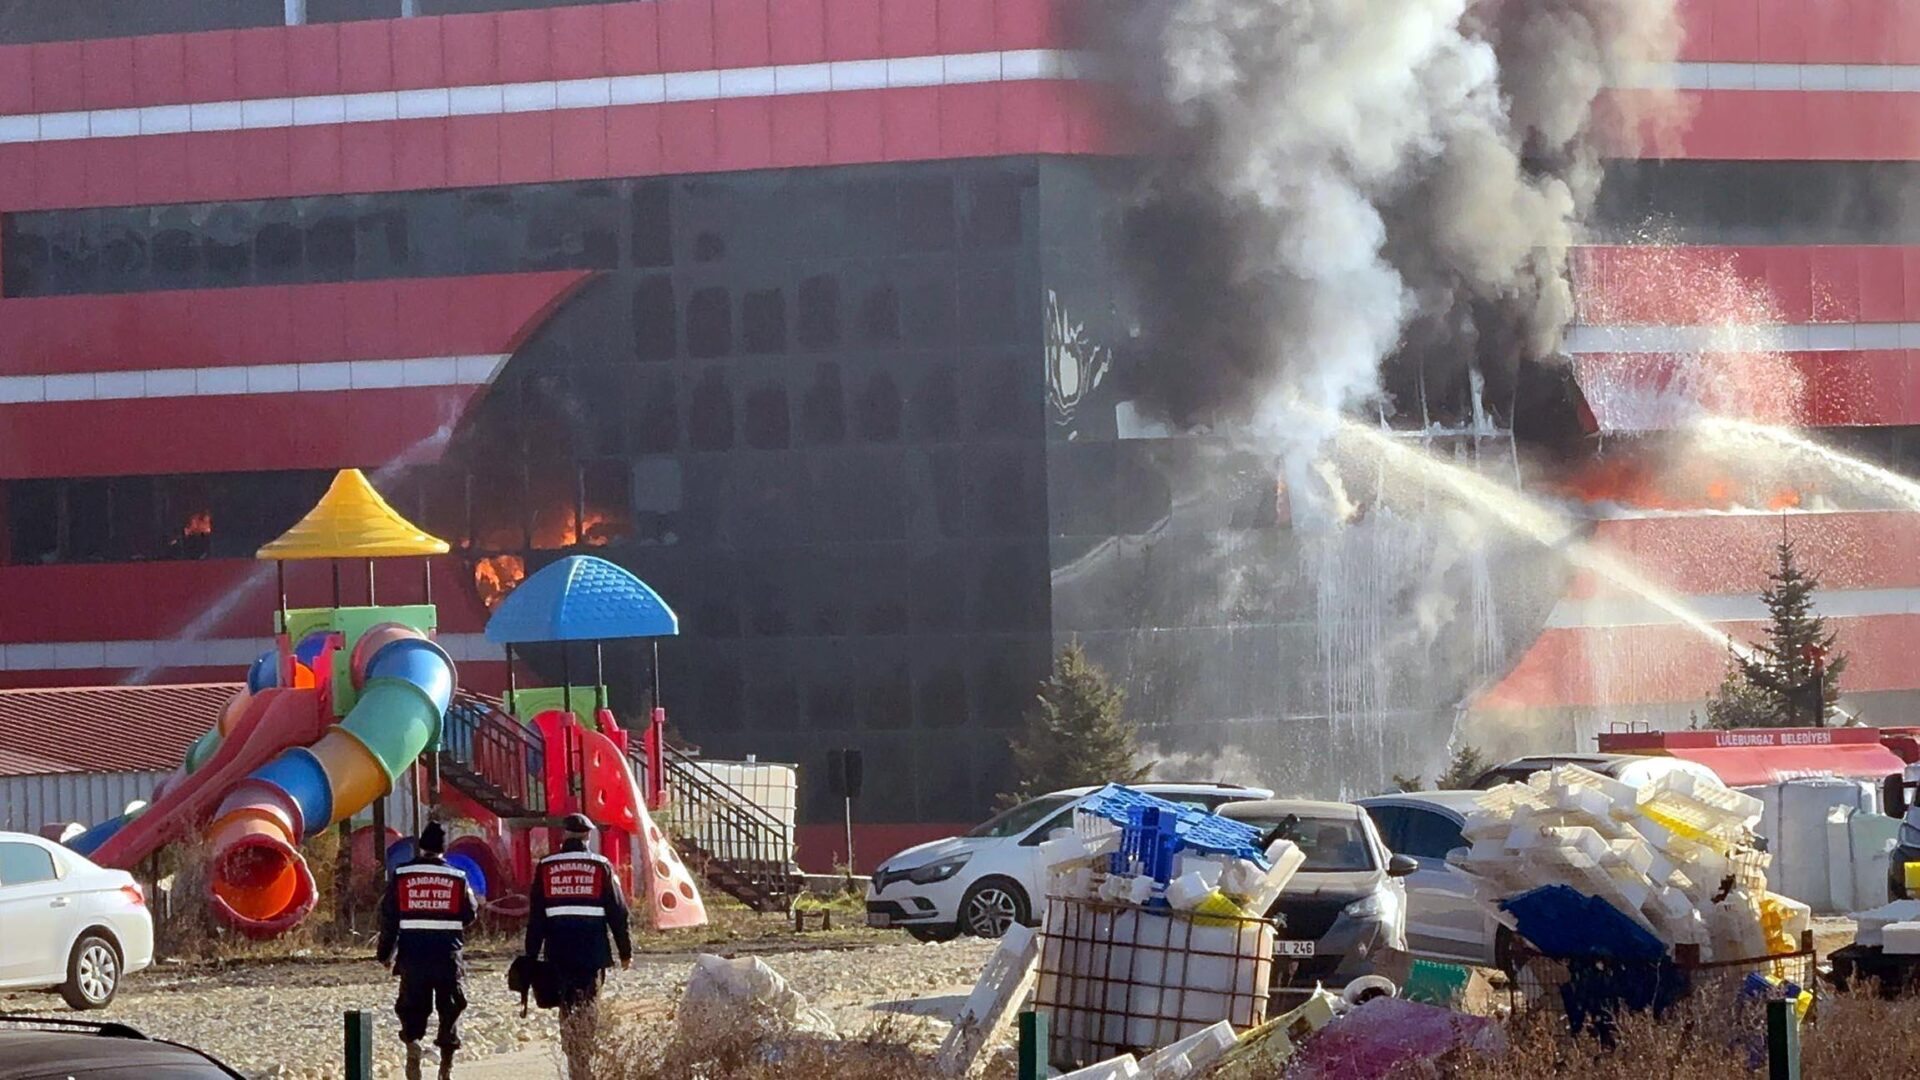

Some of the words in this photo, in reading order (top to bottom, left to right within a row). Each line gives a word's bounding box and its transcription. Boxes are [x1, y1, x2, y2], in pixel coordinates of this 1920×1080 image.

[549, 863, 596, 875] JANDARMA
[406, 876, 454, 888] JANDARMA
[551, 875, 573, 884] OLAY
[408, 889, 430, 898] OLAY
[1293, 942, 1313, 954] 246
